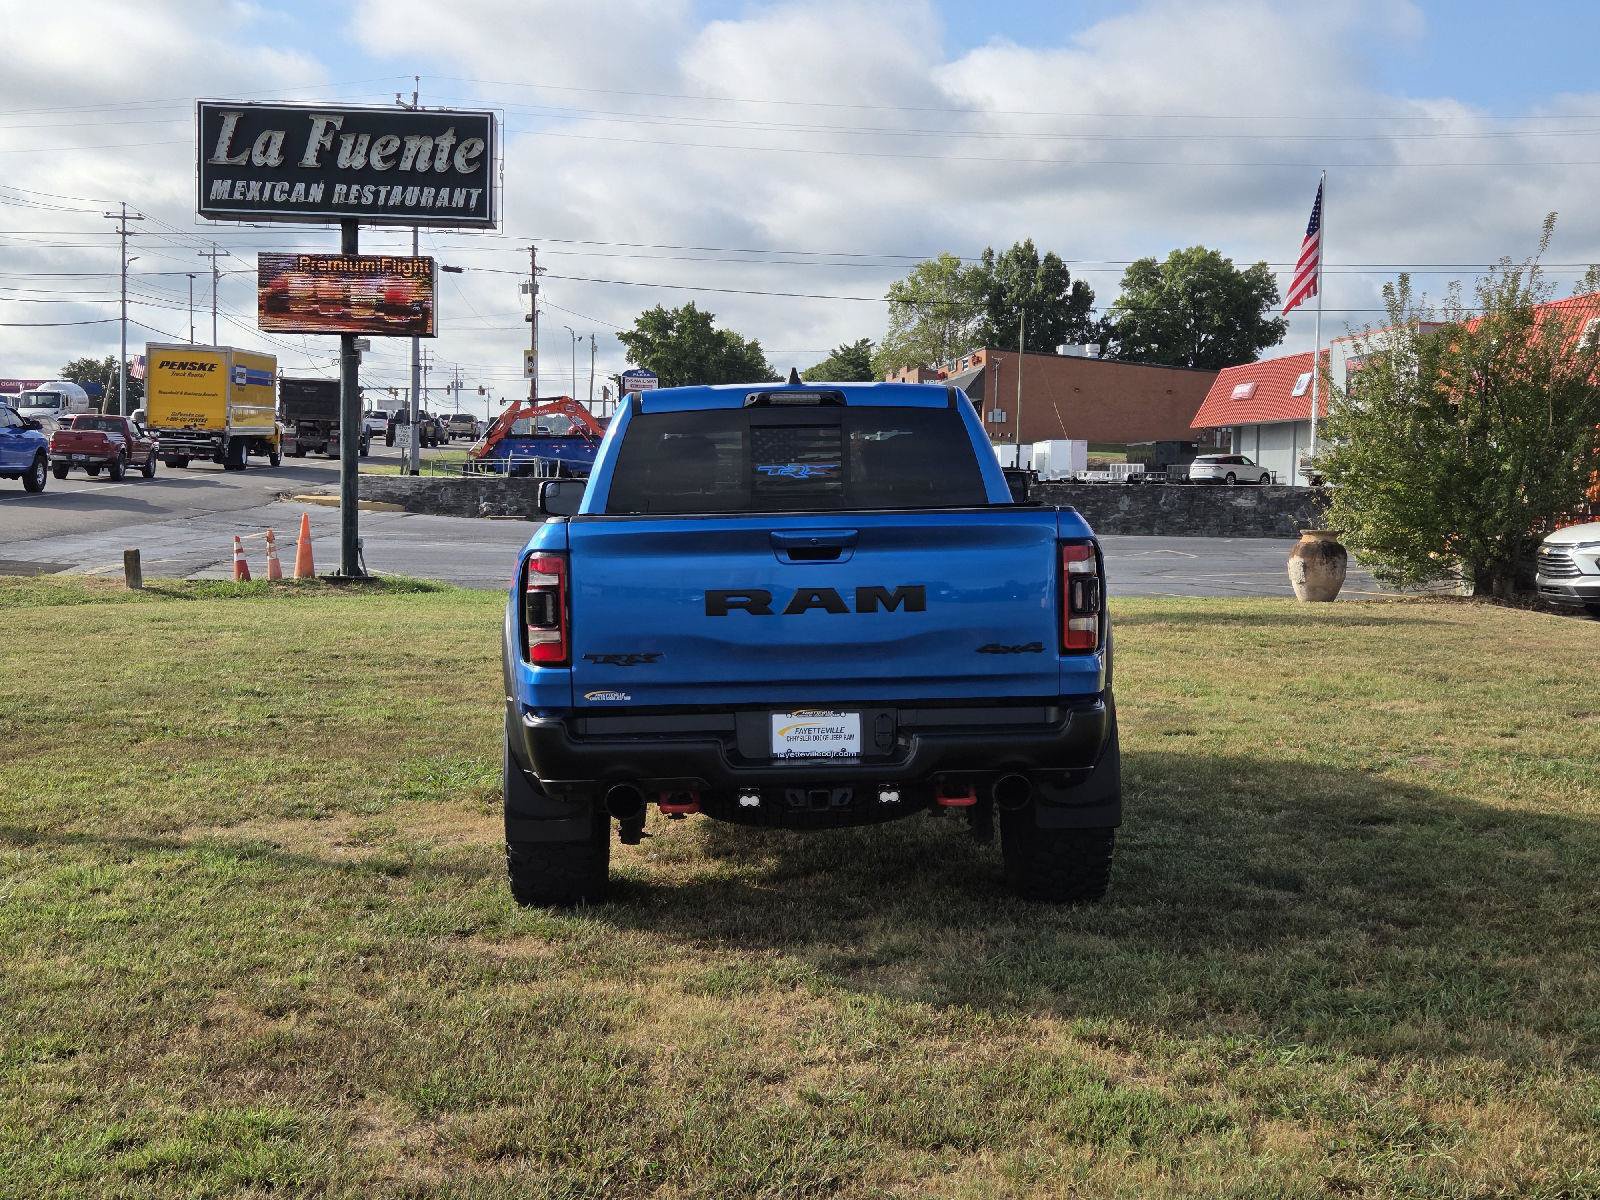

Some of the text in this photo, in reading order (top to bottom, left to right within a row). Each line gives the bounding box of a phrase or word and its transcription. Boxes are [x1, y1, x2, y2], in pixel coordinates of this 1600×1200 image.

[207, 111, 485, 174] La Fuente
[209, 179, 483, 211] MEXICAN RESTAURANT
[300, 257, 430, 277] Premium Flight
[159, 360, 218, 372] PENSKE
[705, 585, 927, 616] RAM
[794, 726, 846, 735] FAYETTEVILLE
